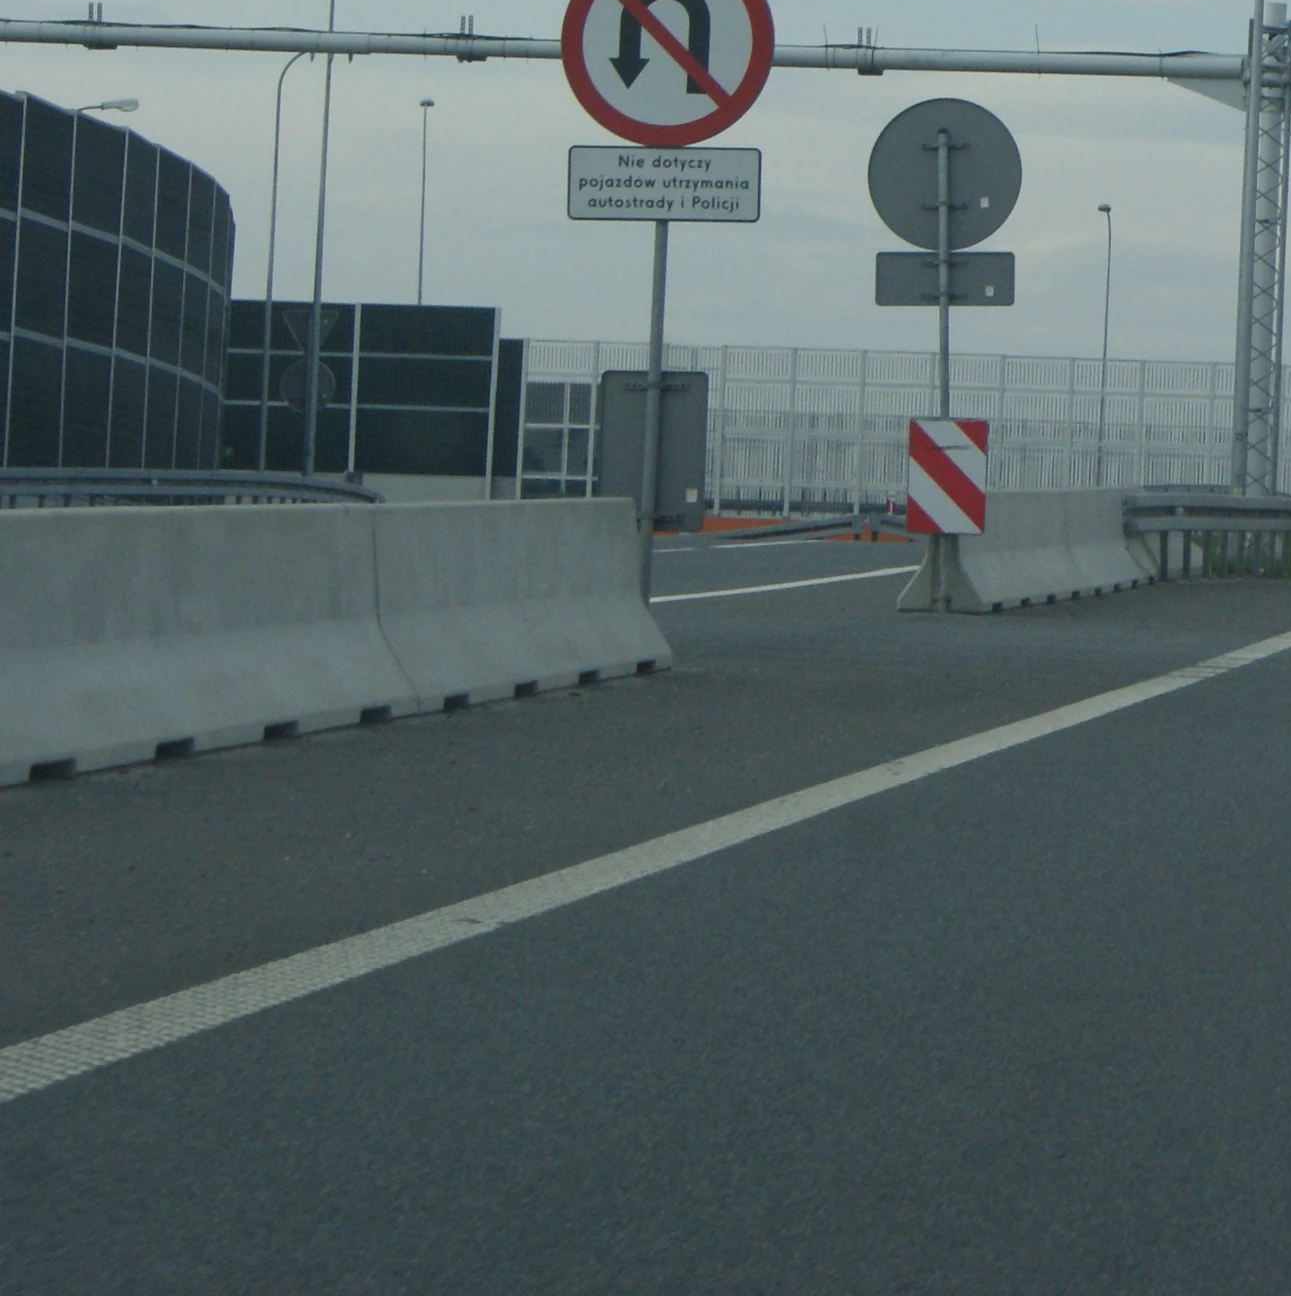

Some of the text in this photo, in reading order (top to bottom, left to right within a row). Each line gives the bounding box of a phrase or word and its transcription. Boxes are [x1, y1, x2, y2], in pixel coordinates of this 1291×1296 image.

[618, 155, 712, 172] Nie dotyczy
[579, 176, 750, 191] pojazdów utrzymania
[587, 196, 740, 213] autostrady i Policji
